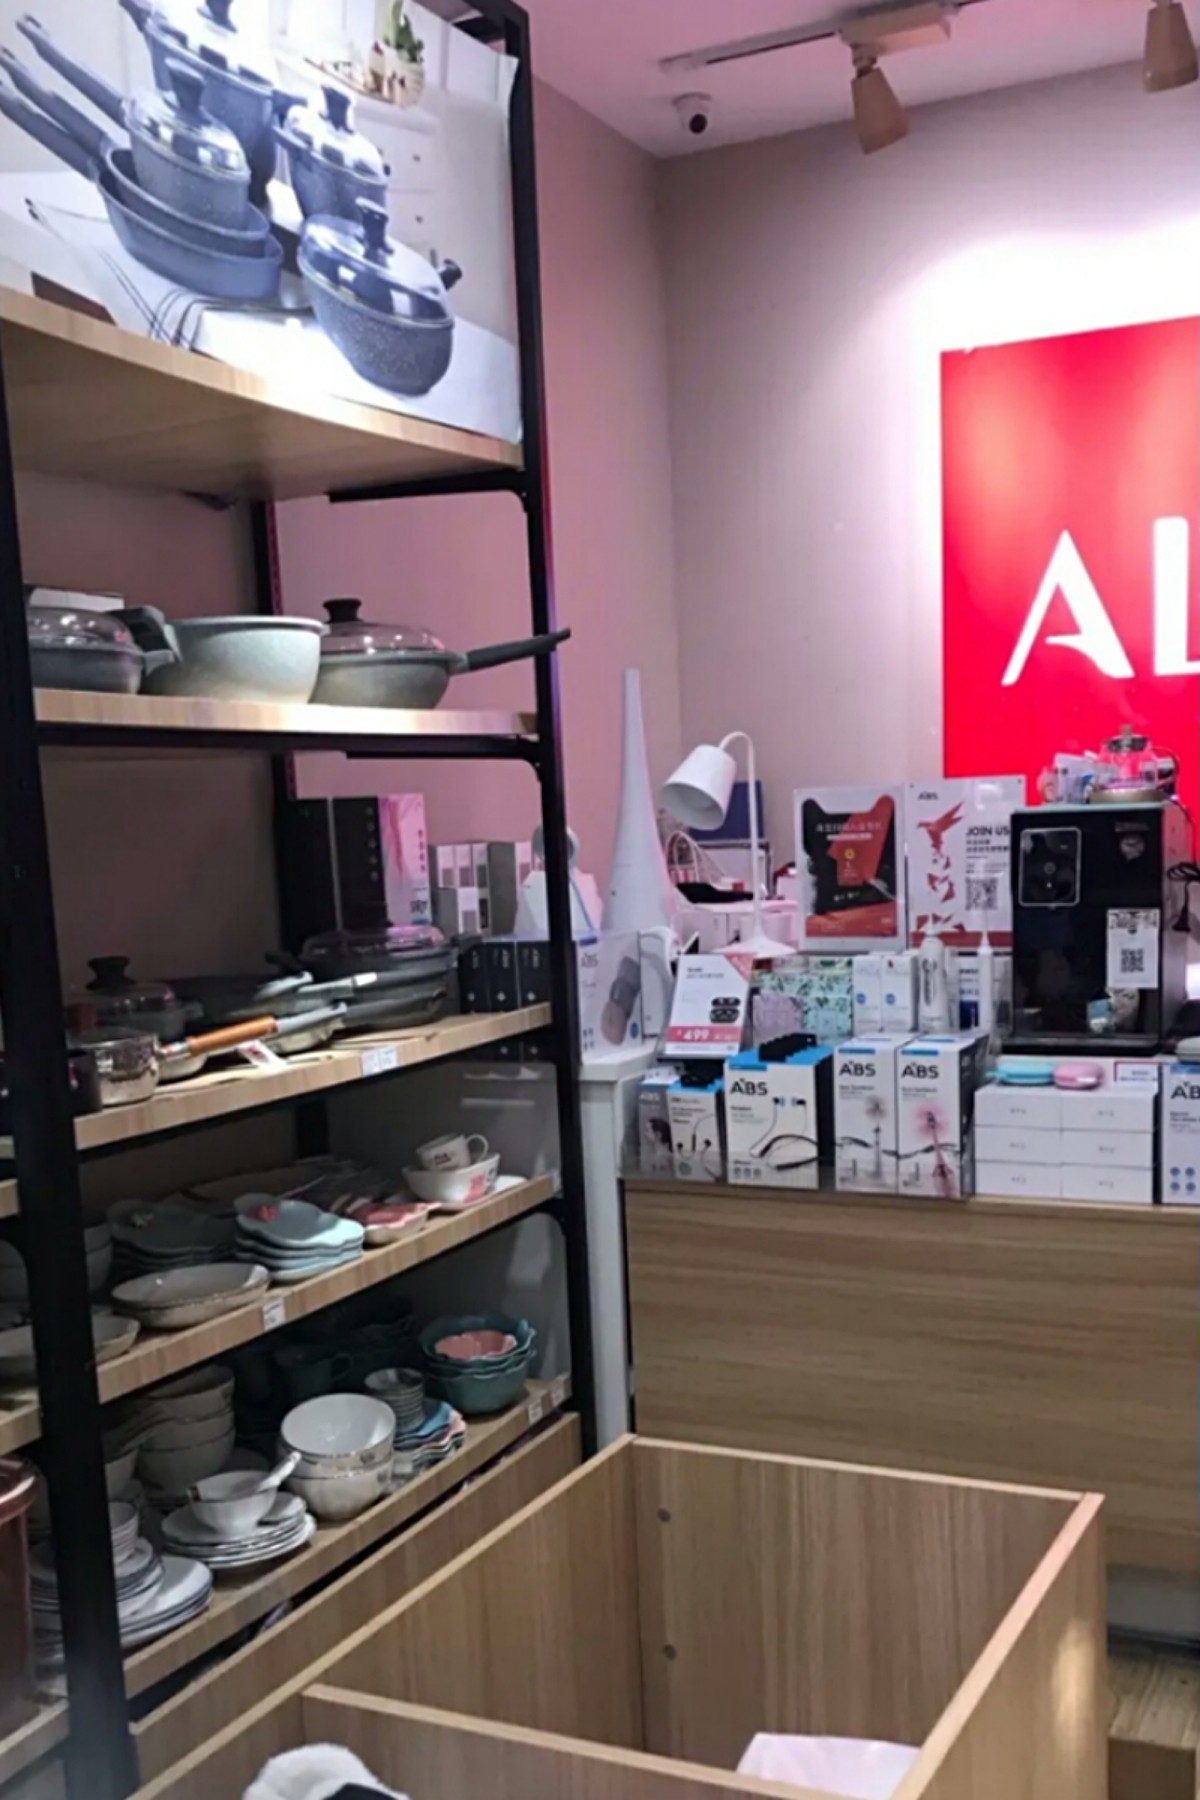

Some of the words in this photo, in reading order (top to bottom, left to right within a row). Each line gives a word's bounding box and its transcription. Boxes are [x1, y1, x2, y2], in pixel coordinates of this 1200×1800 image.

[966, 827, 992, 836] JOIN
[996, 826, 1010, 835] US
[838, 1061, 876, 1077] ABS
[901, 1062, 939, 1079] ABS
[730, 1078, 768, 1096] ABS
